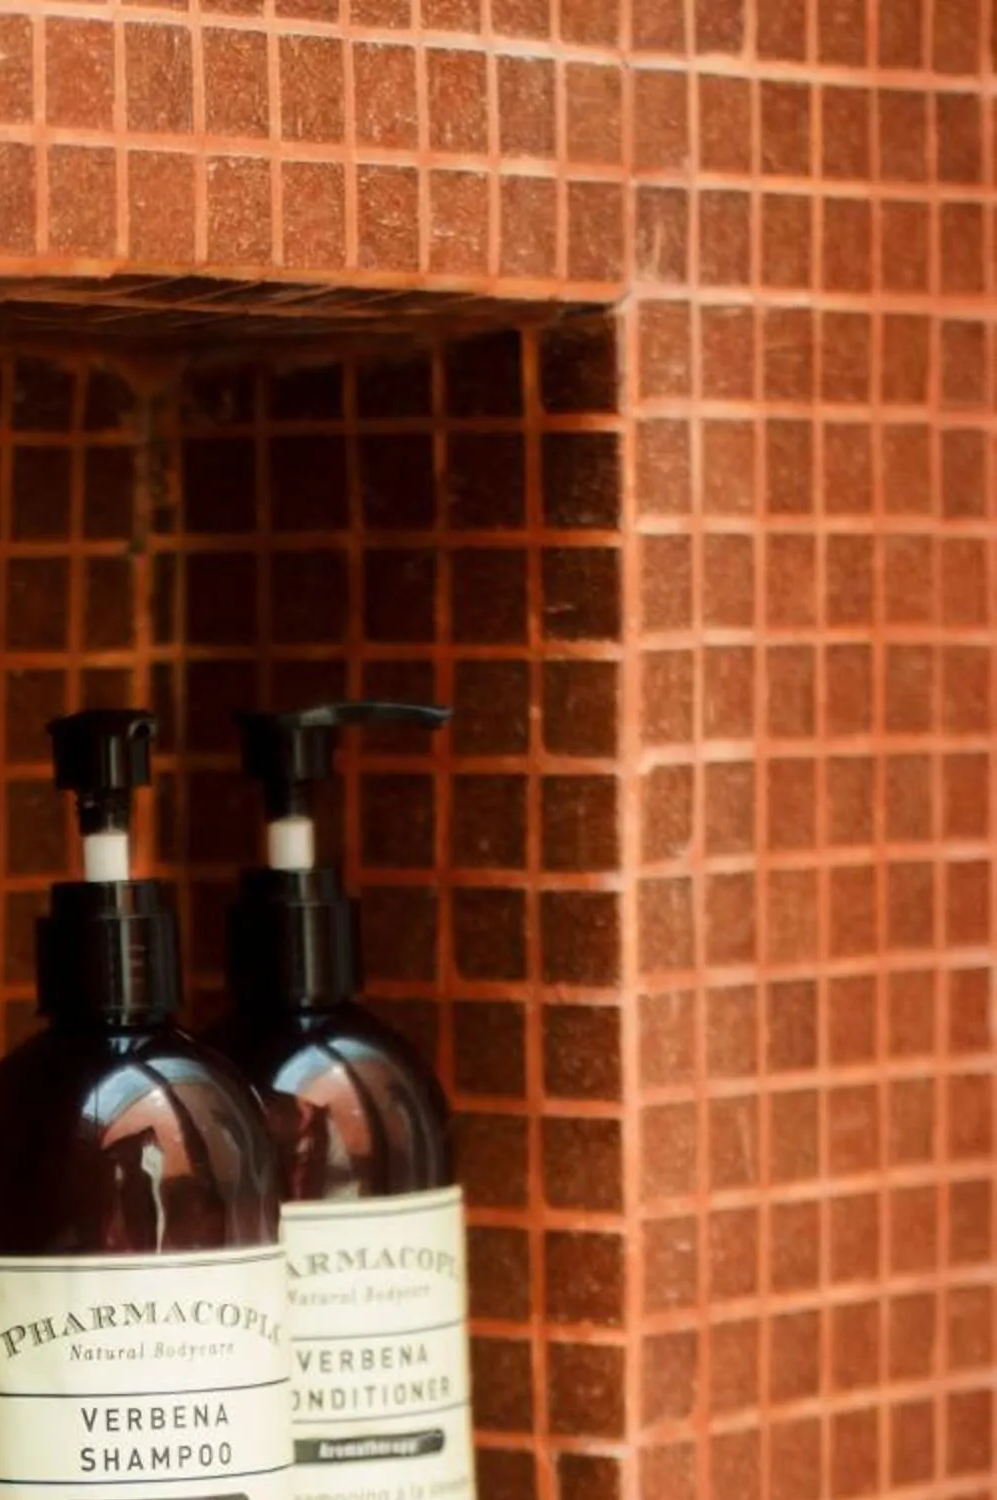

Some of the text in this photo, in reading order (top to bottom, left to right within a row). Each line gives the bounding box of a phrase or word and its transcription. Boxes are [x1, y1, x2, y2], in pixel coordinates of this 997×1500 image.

[69, 1341, 234, 1362] Natural Bodycare
[297, 1343, 428, 1373] VERBENA
[81, 1404, 230, 1432] VERBENA
[81, 1442, 232, 1471] SHAMPOO
